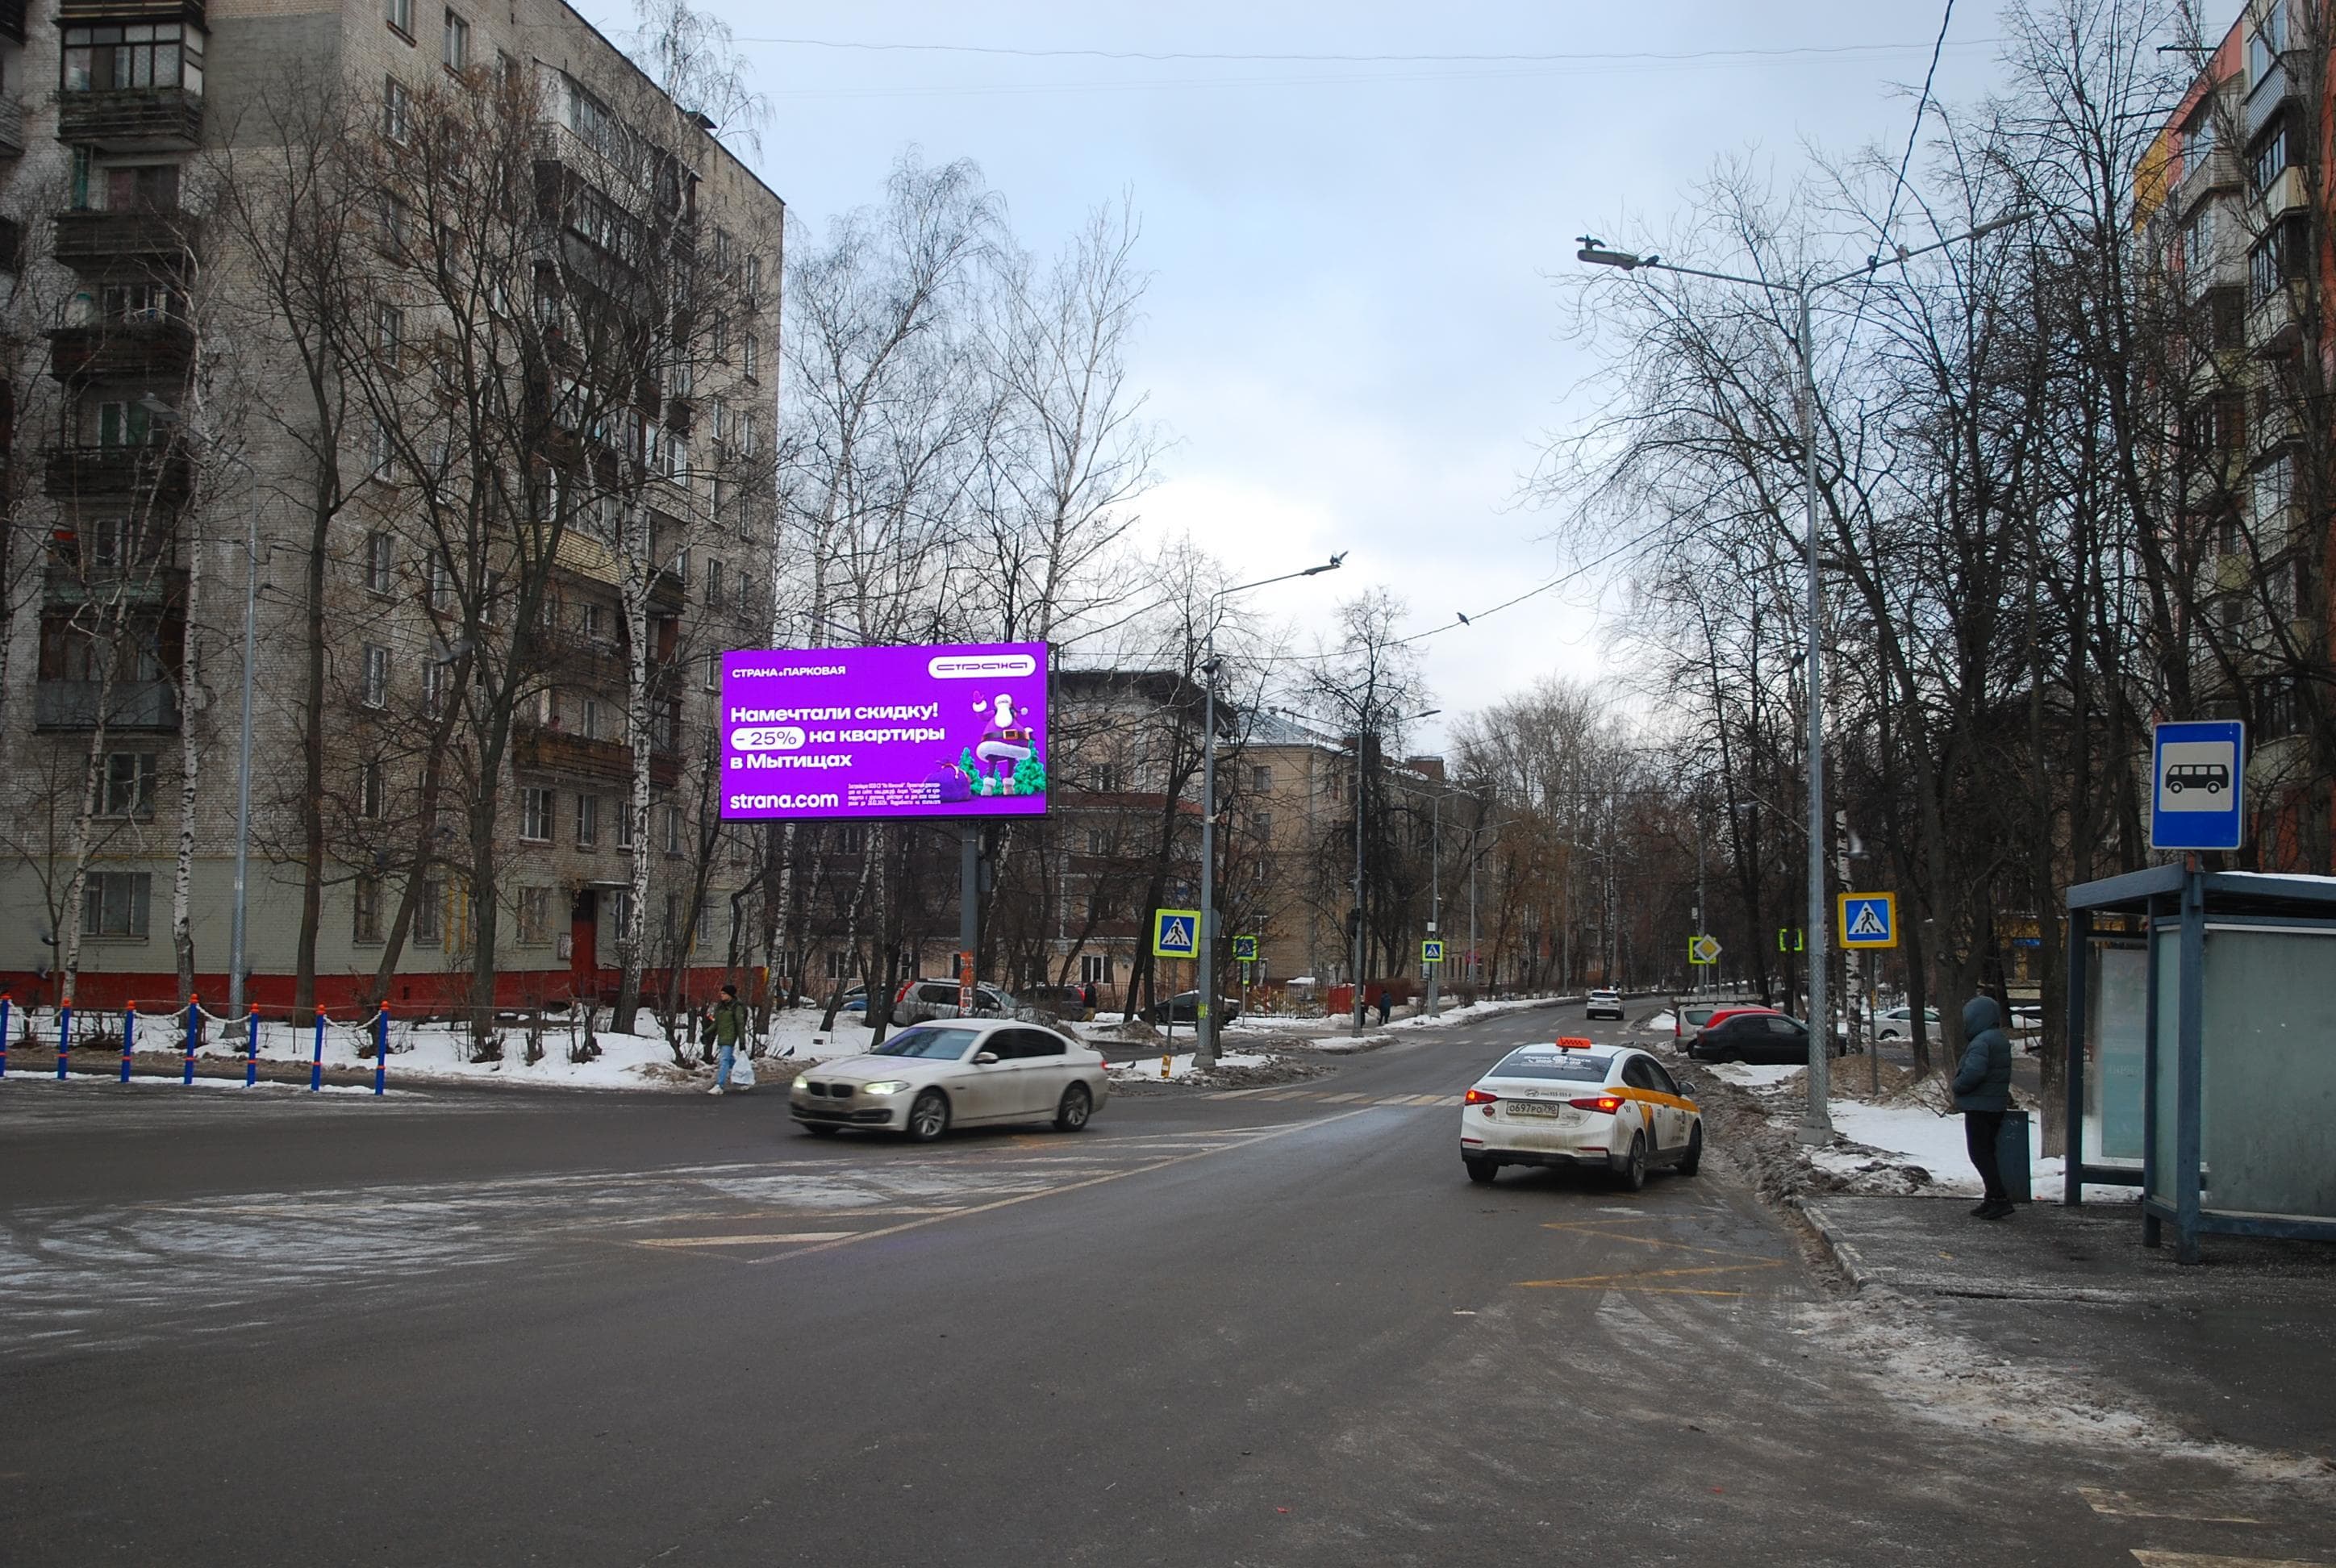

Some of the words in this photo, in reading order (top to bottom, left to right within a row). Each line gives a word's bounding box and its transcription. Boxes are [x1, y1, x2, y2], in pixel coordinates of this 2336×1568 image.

[731, 707, 851, 724] Намечтали
[854, 702, 939, 722] скидку!
[809, 728, 836, 744] на
[840, 726, 945, 745] квартиры
[730, 757, 743, 770] в
[746, 753, 853, 770] Мытищах
[730, 791, 839, 809] strana.com
